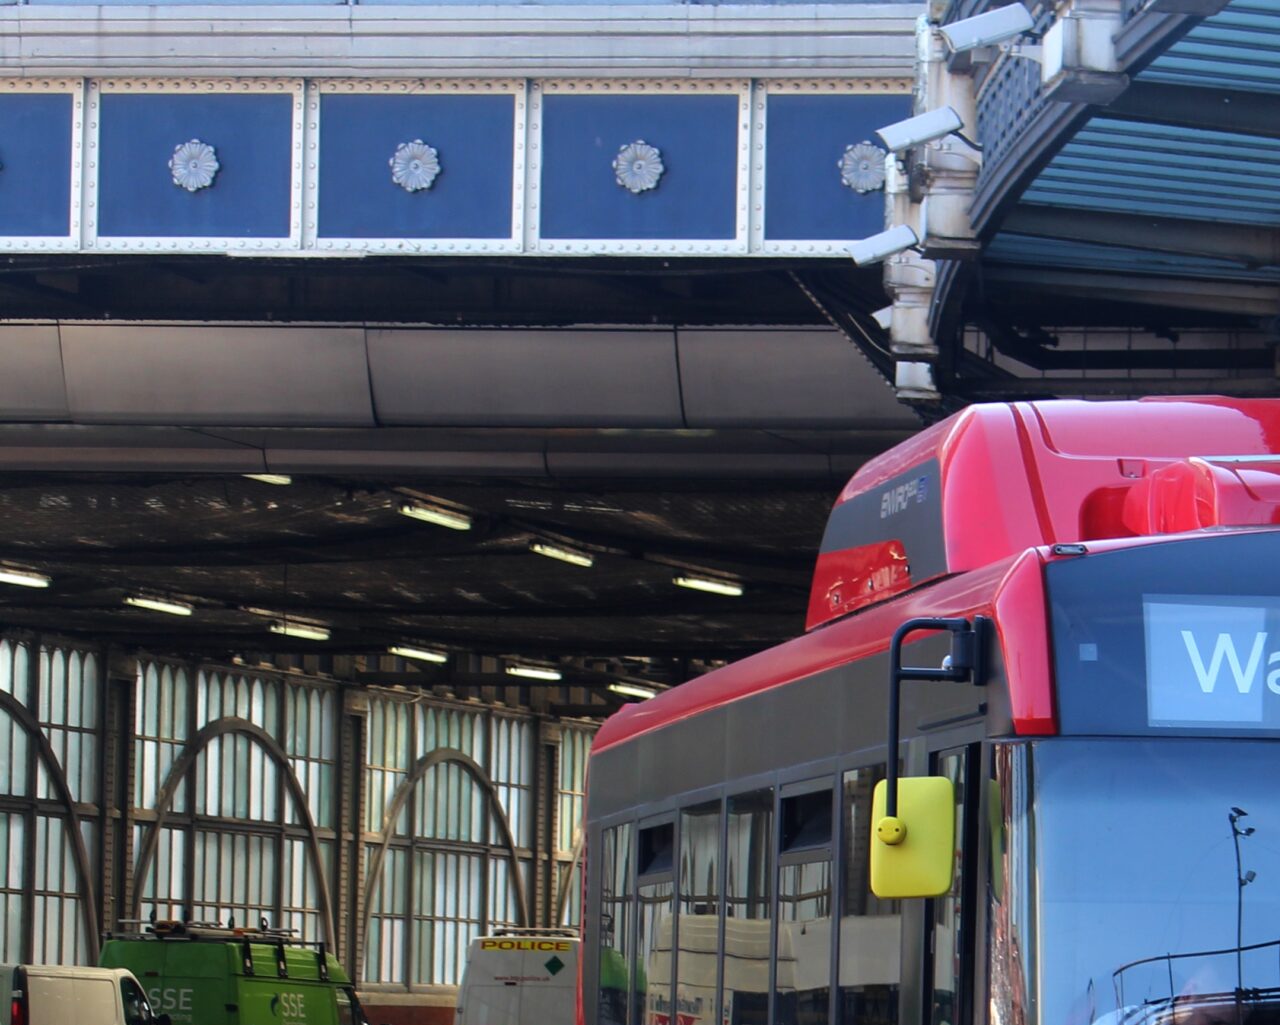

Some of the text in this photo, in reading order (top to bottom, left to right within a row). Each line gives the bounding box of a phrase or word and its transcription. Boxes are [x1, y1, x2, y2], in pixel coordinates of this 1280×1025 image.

[481, 940, 570, 951] POLICE
[148, 987, 194, 1010] SSE
[281, 992, 306, 1018] SSE
